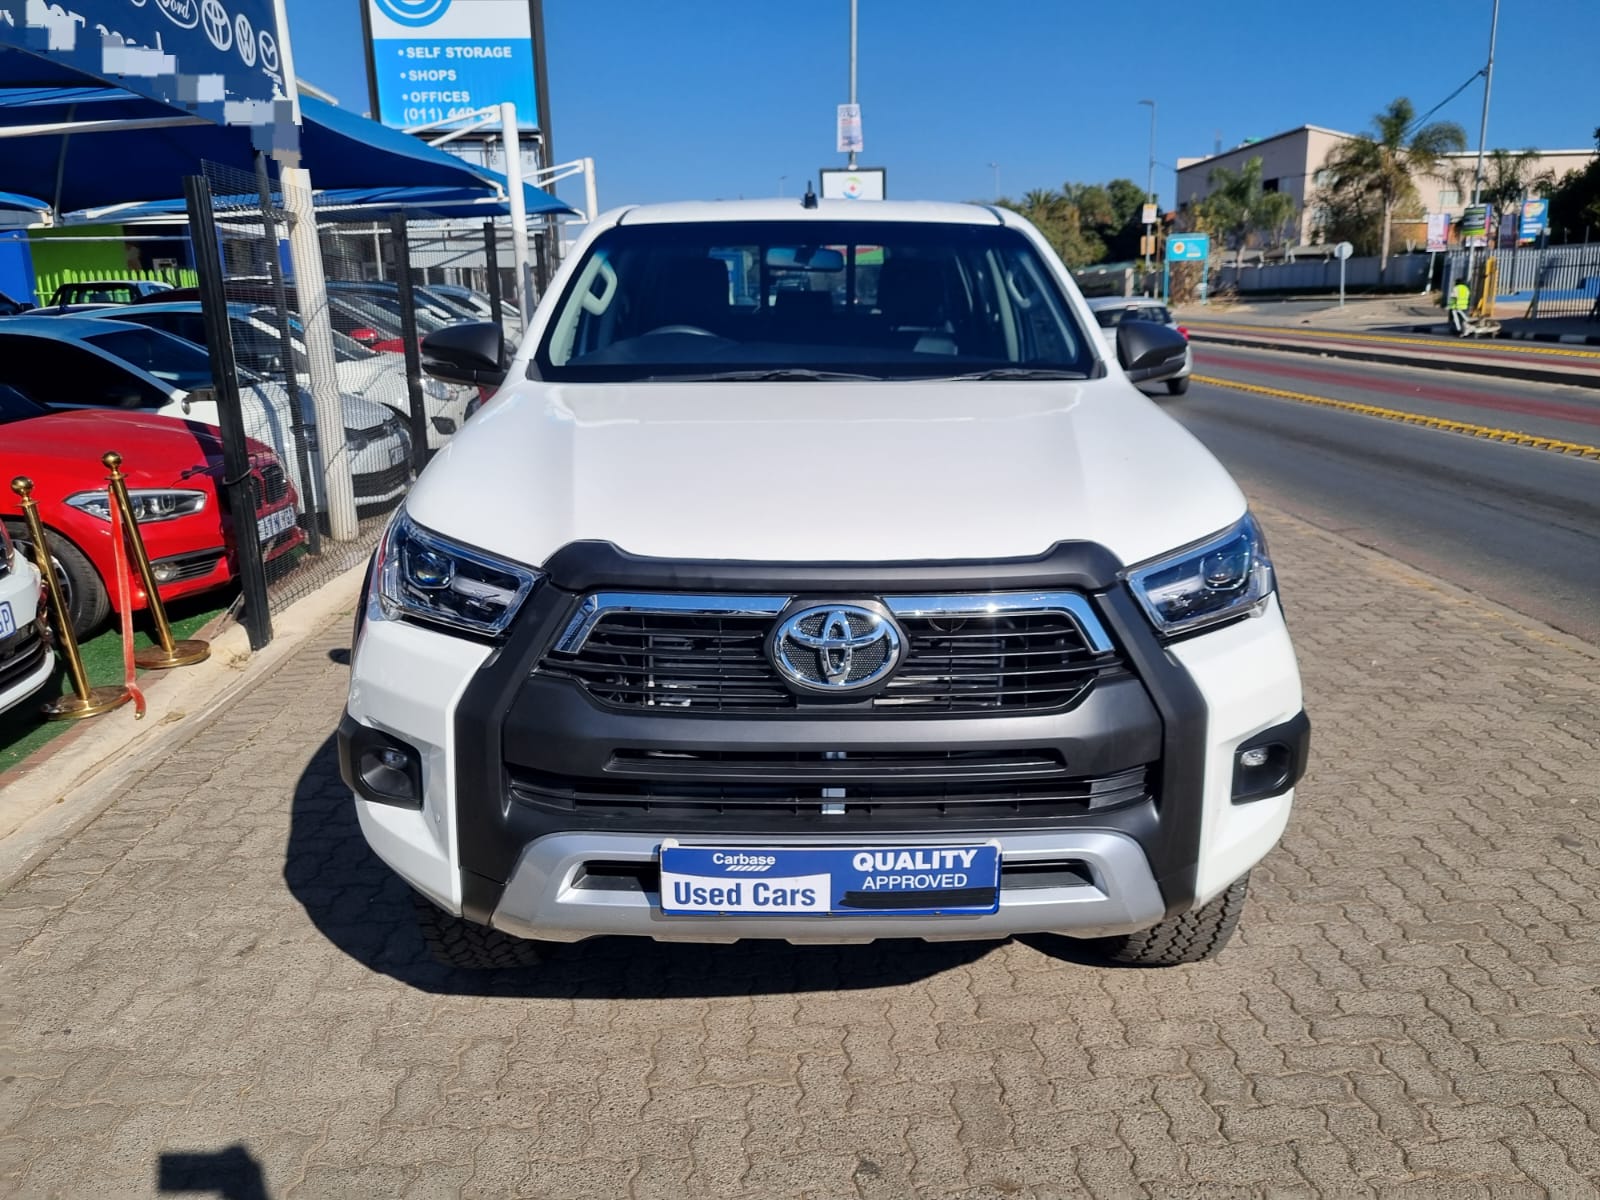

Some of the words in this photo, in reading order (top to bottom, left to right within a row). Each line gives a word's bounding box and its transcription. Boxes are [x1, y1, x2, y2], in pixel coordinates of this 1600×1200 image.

[406, 47, 441, 58] SELF
[446, 46, 512, 58] STORAGE
[409, 70, 456, 81] SHOPS
[411, 91, 470, 102] OFFICES
[404, 108, 442, 124] (011)
[712, 852, 776, 865] Carbase
[852, 849, 978, 873] QUALITY
[862, 873, 968, 890] APPROVED
[674, 881, 742, 906] Used
[752, 882, 816, 907] Cars
